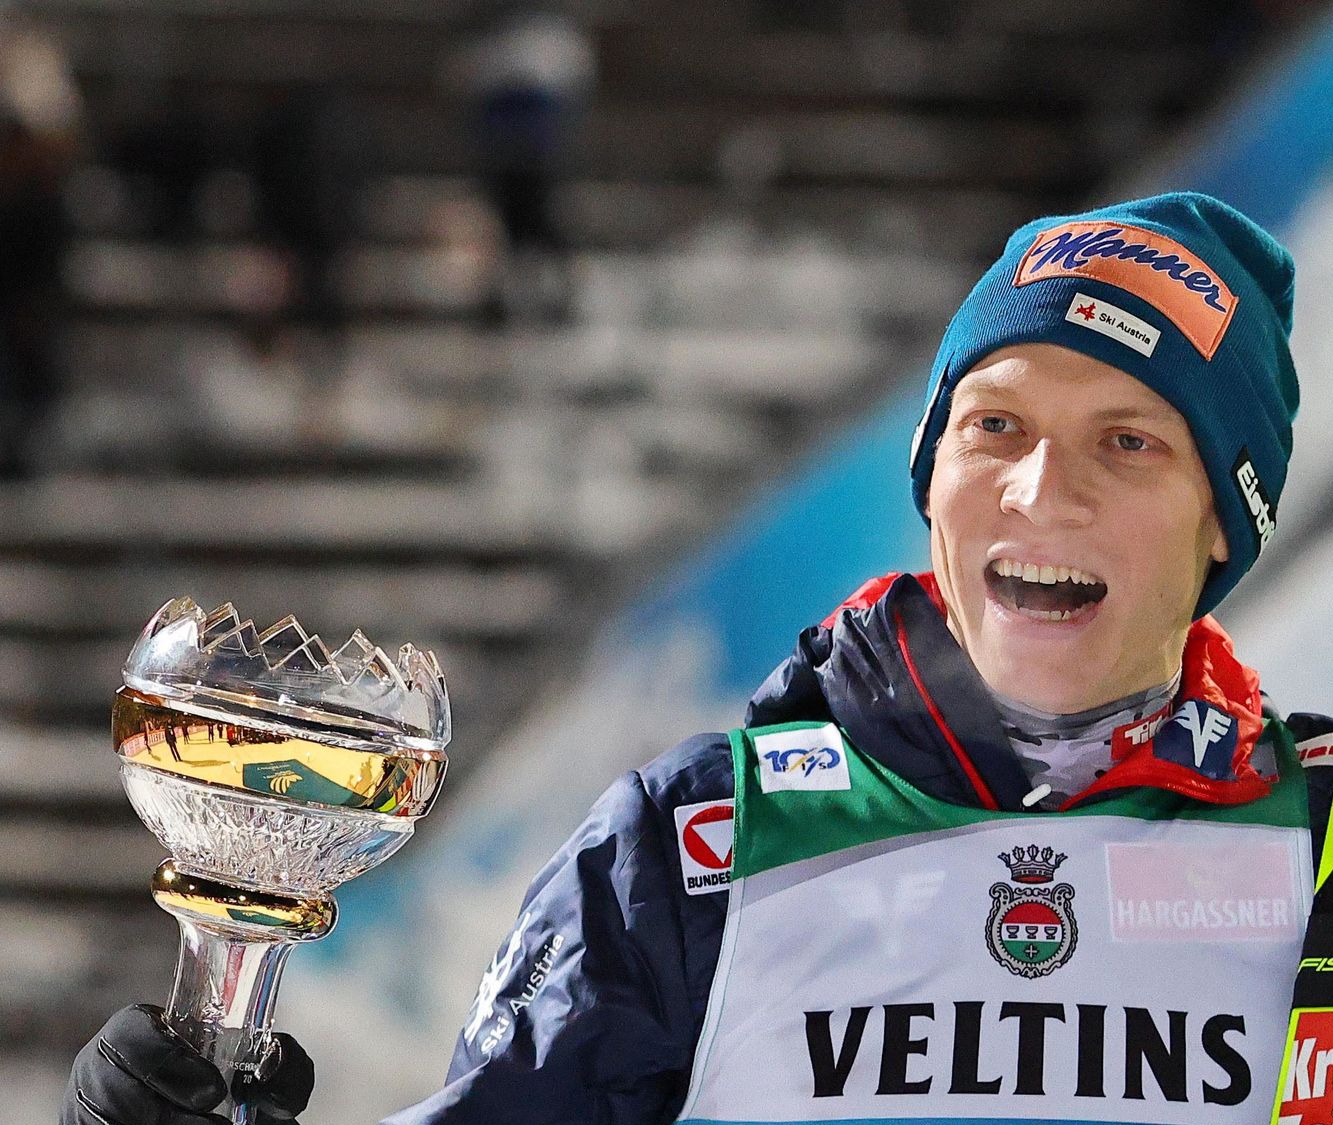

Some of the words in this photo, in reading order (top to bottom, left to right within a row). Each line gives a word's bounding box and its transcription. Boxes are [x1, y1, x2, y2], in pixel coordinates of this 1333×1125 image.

[1031, 229, 1226, 313] Manner
[1099, 311, 1117, 326] Ski
[1116, 319, 1151, 346] Austria
[1114, 897, 1292, 930] HARGASSNER
[481, 1016, 510, 1055] Ski
[509, 934, 564, 1015] Austria
[803, 1002, 1252, 1105] VELTINS
